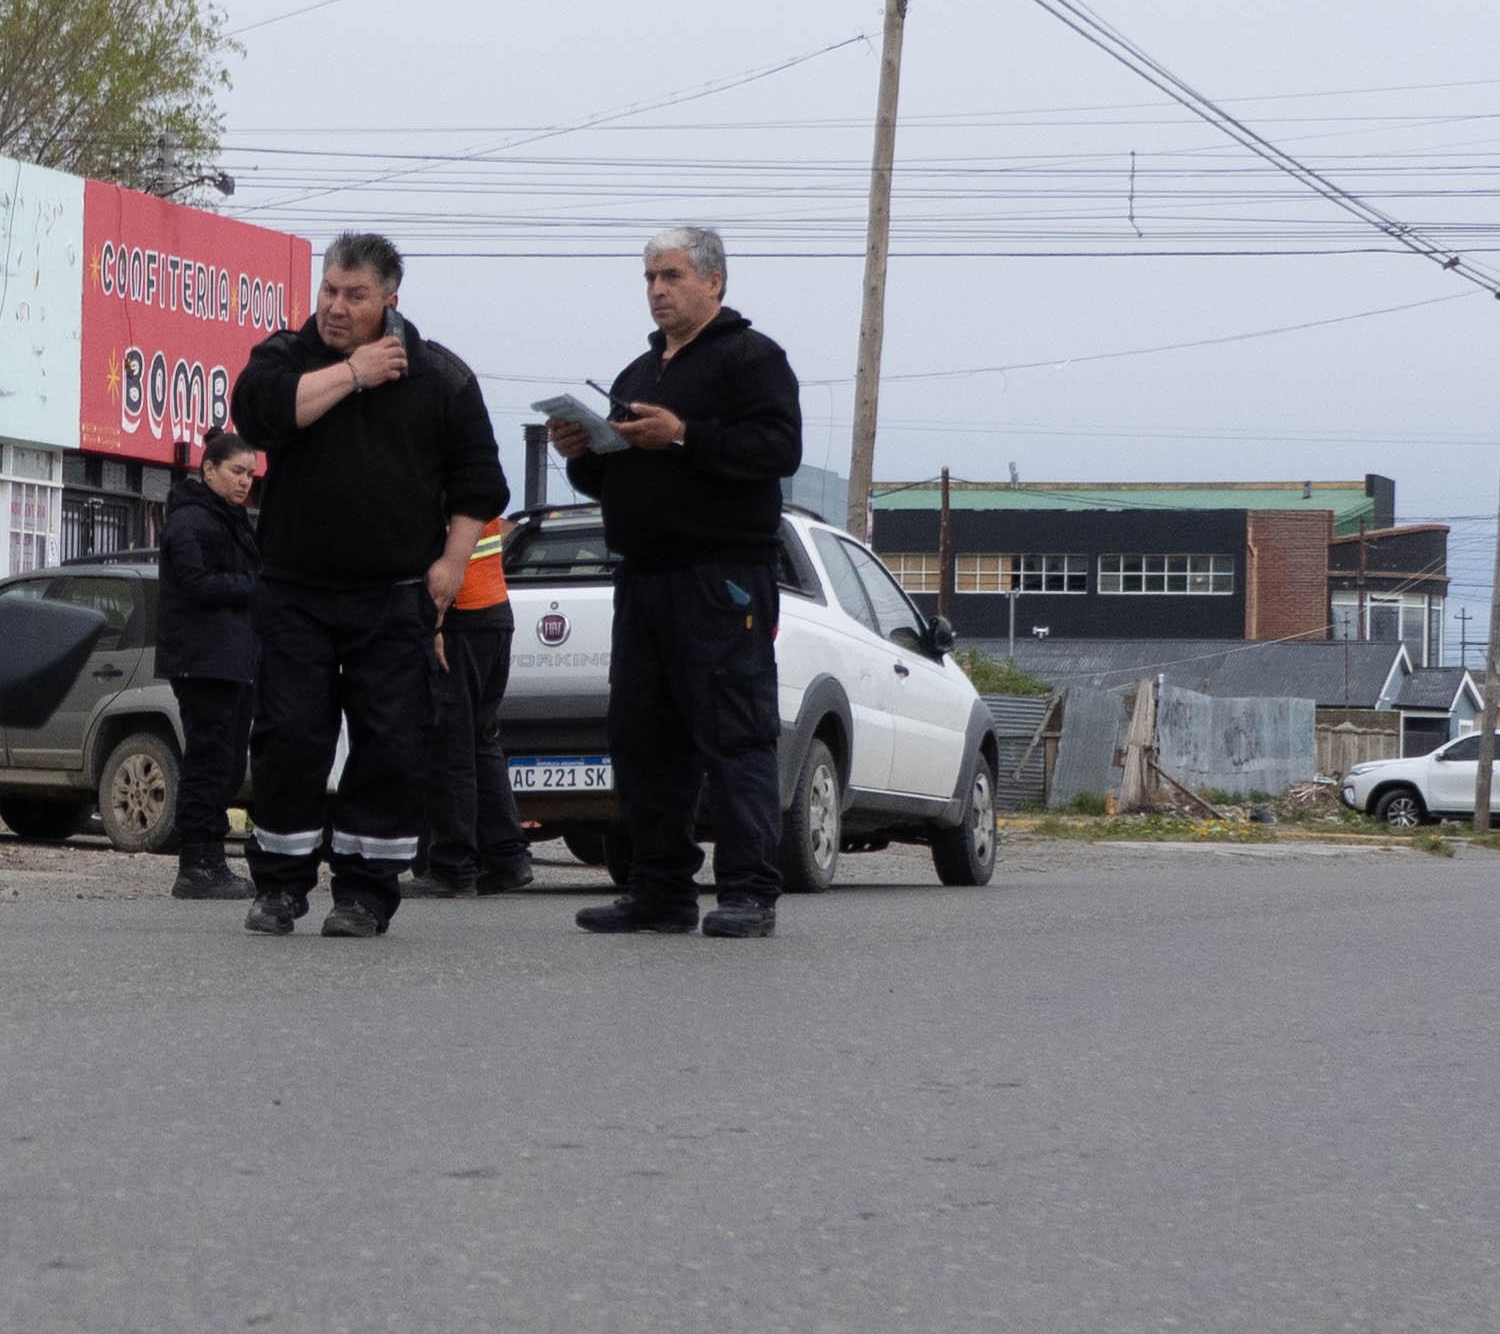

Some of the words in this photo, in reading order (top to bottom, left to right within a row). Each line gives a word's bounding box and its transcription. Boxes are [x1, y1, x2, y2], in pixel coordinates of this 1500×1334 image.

[101, 240, 230, 322] CONFITERIA
[239, 273, 288, 331] POOL
[122, 346, 231, 447] BOMB
[544, 621, 562, 636] FIAT
[513, 769, 536, 788] AC
[543, 768, 577, 787] 221
[584, 767, 607, 786] SK
